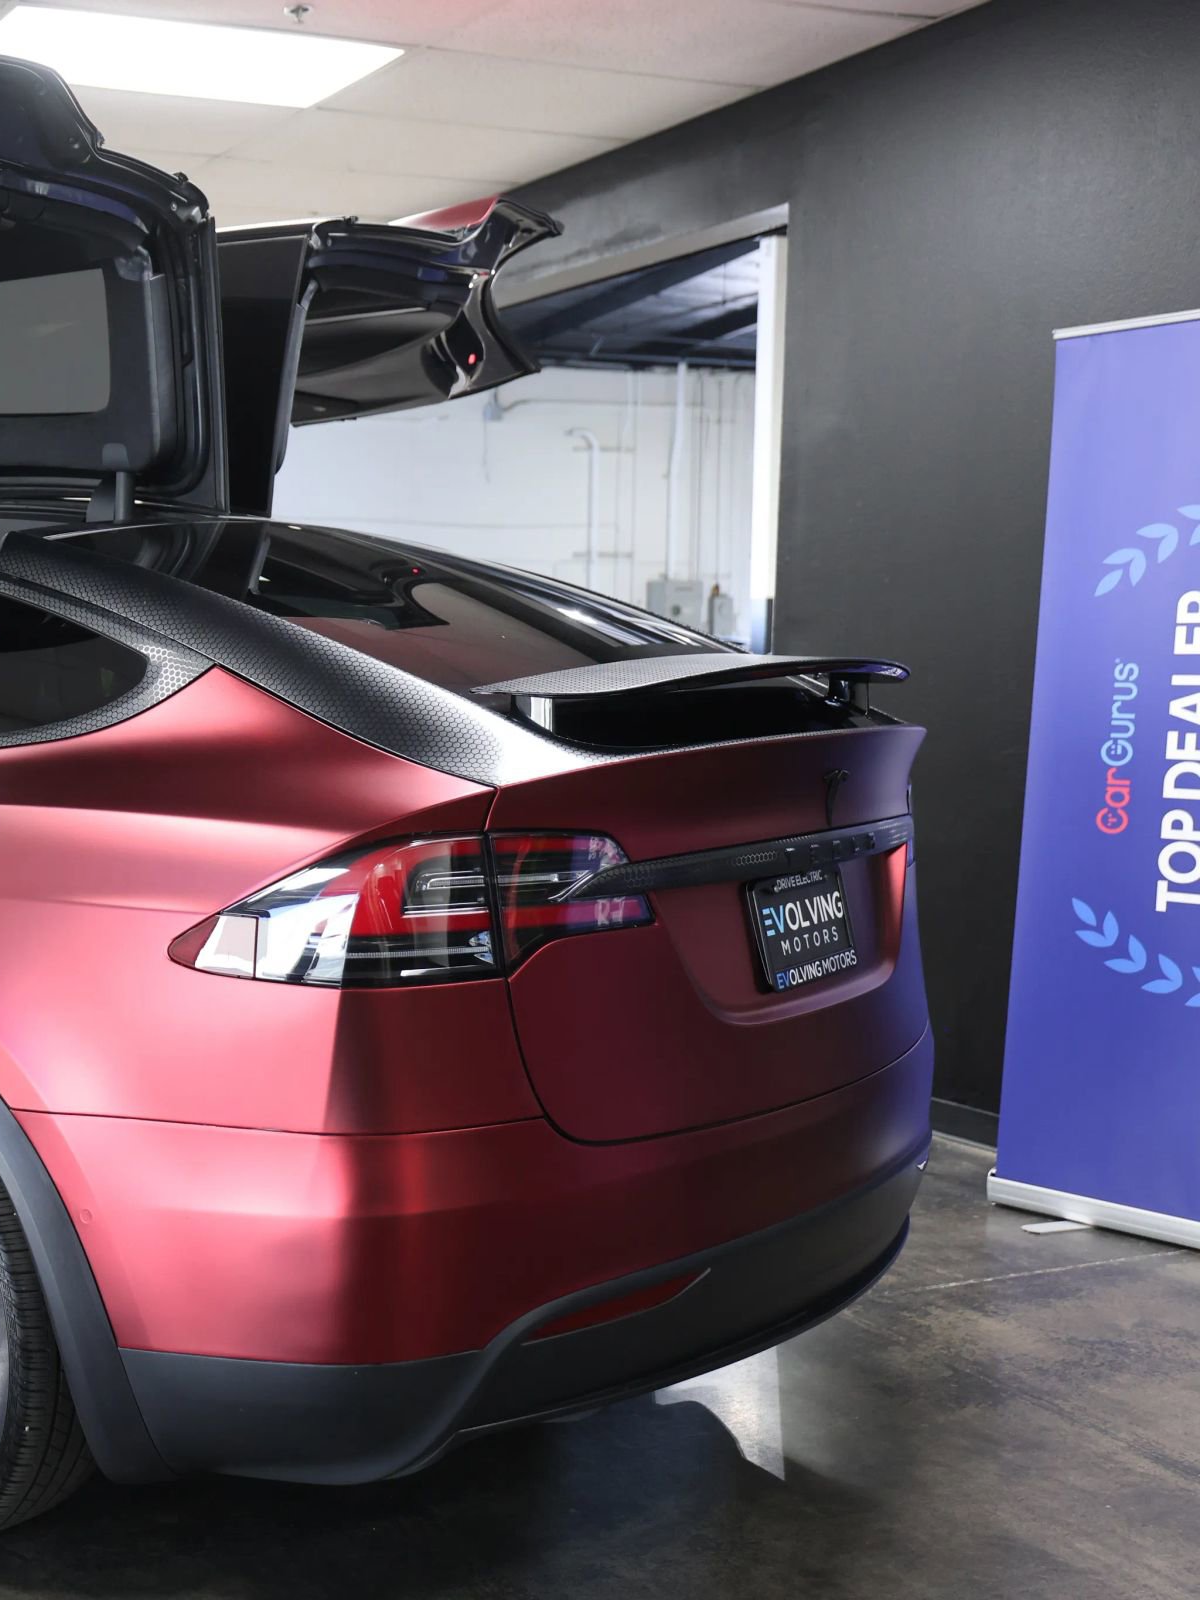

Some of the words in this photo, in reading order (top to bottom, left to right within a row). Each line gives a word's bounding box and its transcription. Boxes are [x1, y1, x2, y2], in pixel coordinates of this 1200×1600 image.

[1096, 661, 1139, 835] CarGurus
[776, 874, 796, 890] DRIVE
[796, 869, 823, 886] ELECTRIC
[1155, 808, 1200, 912] TOP
[762, 890, 844, 937] EVOLVING
[781, 926, 839, 956] MOTORS
[776, 961, 822, 989] EVOLVING
[821, 949, 857, 974] MOTORS
